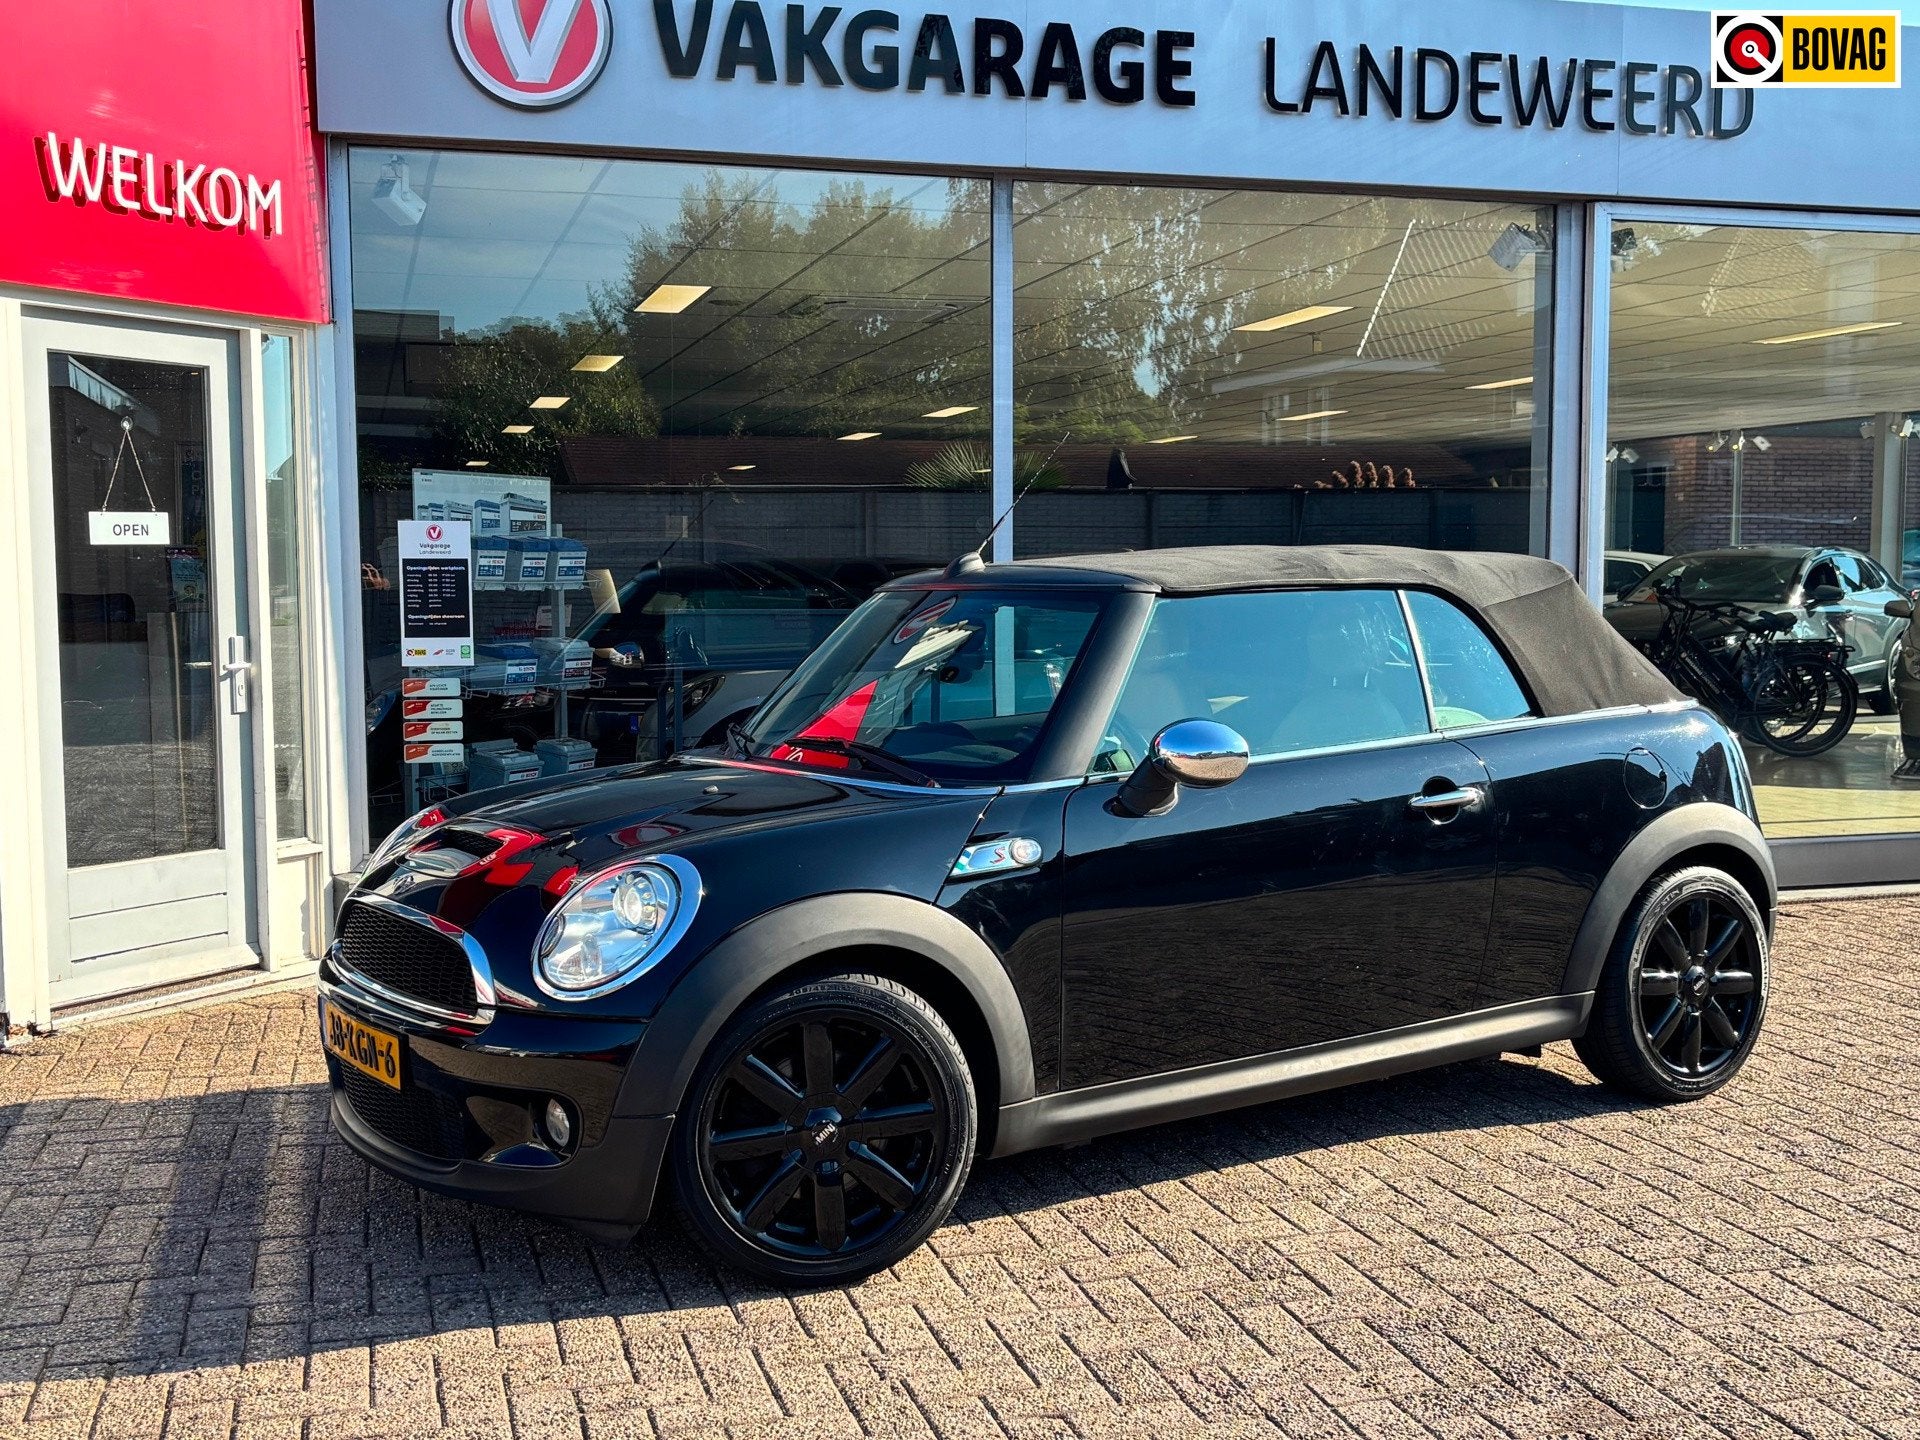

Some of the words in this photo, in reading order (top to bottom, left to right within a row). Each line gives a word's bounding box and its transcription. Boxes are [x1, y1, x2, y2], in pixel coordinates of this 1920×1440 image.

[653, 0, 1196, 107] VAKGARAGE
[1264, 36, 1755, 139] LANDEWEERD
[47, 131, 284, 236] WELKOM
[112, 523, 150, 537] OPEN
[419, 542, 451, 550] Vakgarage
[990, 845, 1006, 865] S
[815, 1123, 836, 1144] MINI
